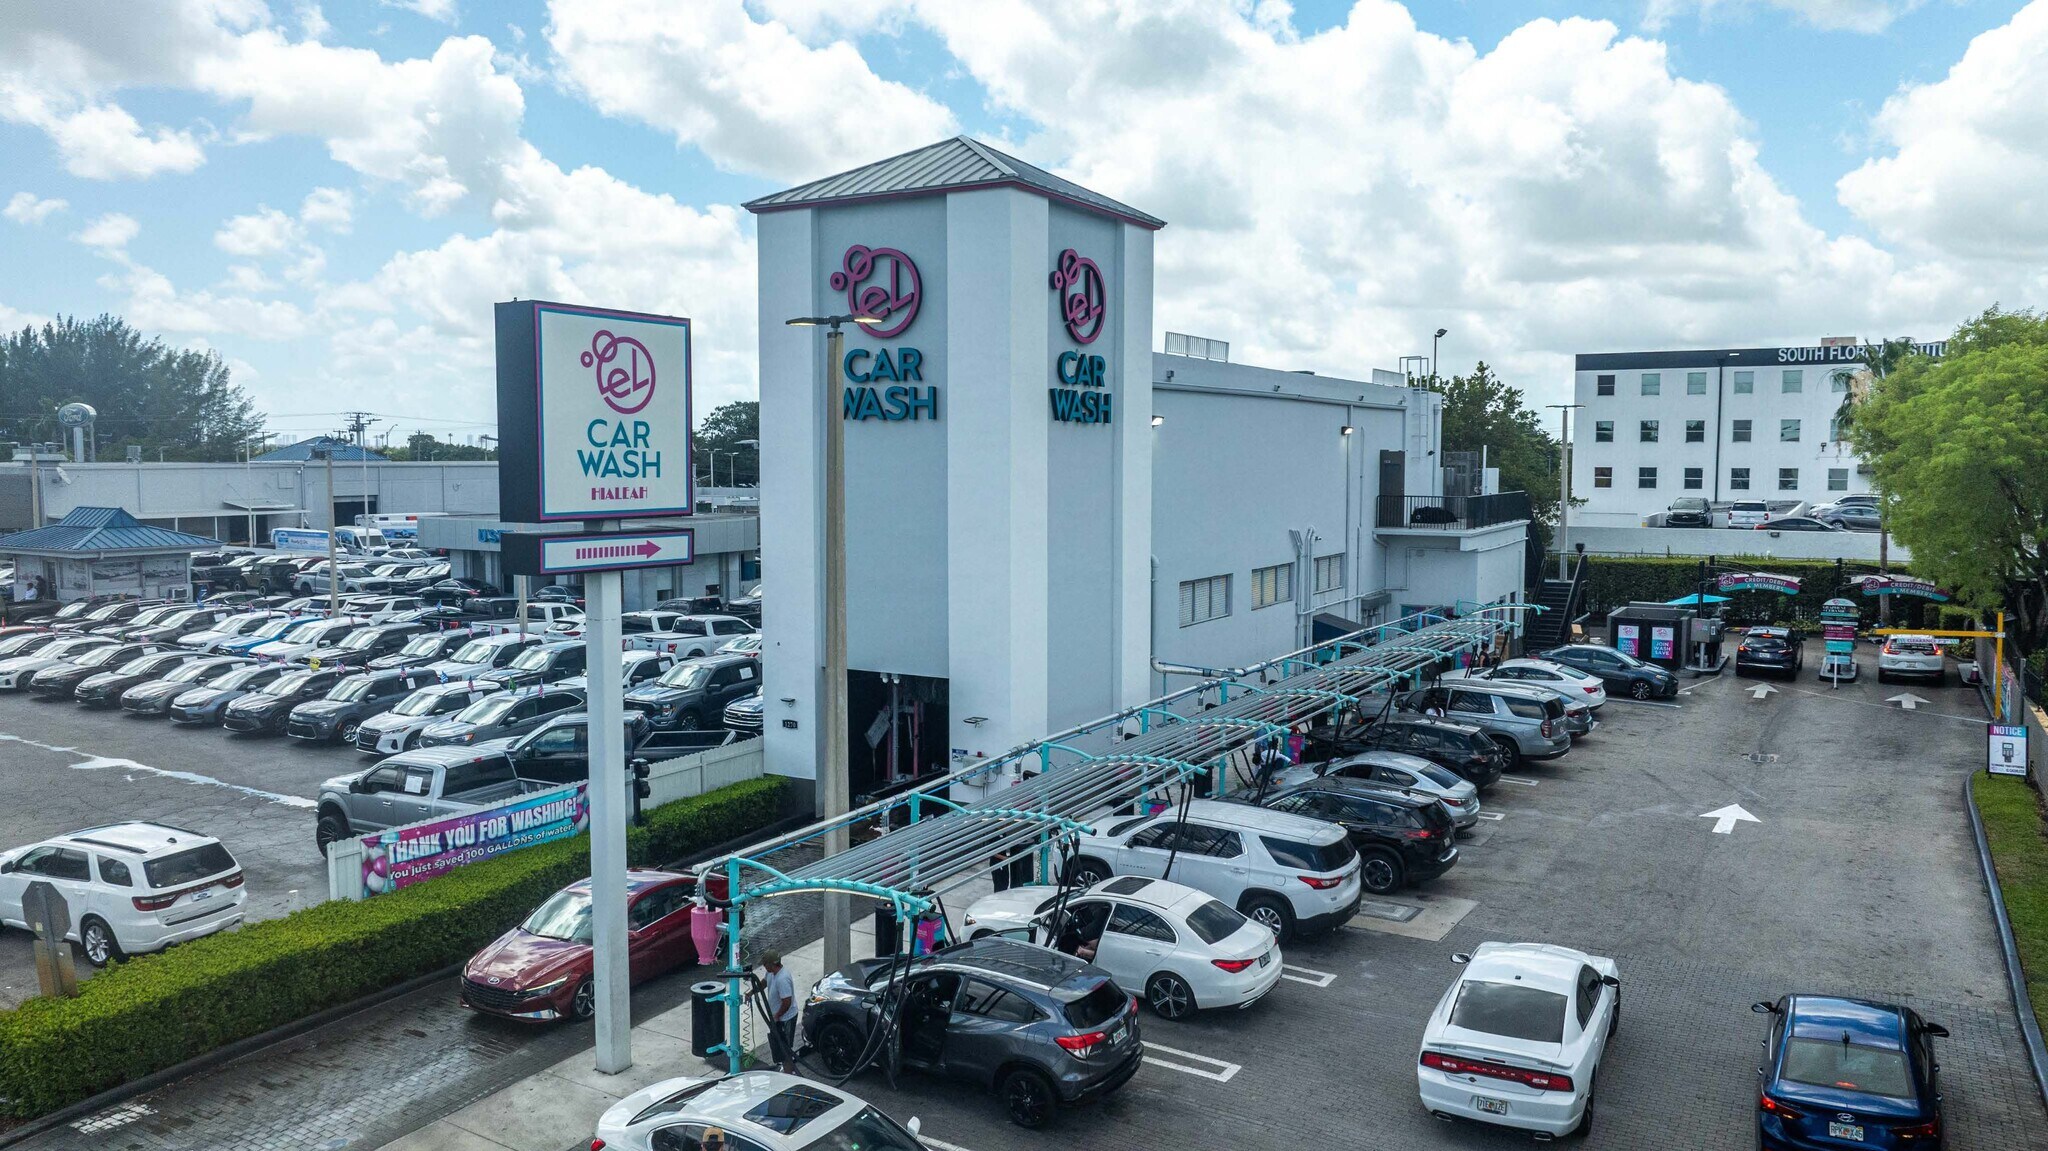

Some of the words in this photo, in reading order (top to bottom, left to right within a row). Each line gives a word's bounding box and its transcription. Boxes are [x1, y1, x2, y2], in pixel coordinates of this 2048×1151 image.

[843, 347, 923, 383] CAR
[1057, 350, 1106, 387] CAR
[1777, 346, 1824, 362] SOUTH
[1049, 388, 1112, 424] WASH
[587, 418, 650, 448] CAR
[576, 449, 661, 478] WASH
[591, 486, 648, 501] HIALEAH
[1753, 583, 1785, 592] MEMBERS
[1899, 588, 1933, 598] MEMBERS
[1993, 725, 2023, 736] NOTICE
[388, 831, 442, 864] THANK
[444, 823, 477, 848] YOU
[479, 816, 509, 841] FOR
[510, 797, 578, 832] WASHING!
[390, 869, 409, 880] You
[411, 862, 432, 876] just
[434, 853, 464, 869] saved
[466, 848, 485, 860] 100
[487, 834, 534, 854] GALLONS
[535, 829, 546, 841] of
[547, 822, 575, 838] water!
